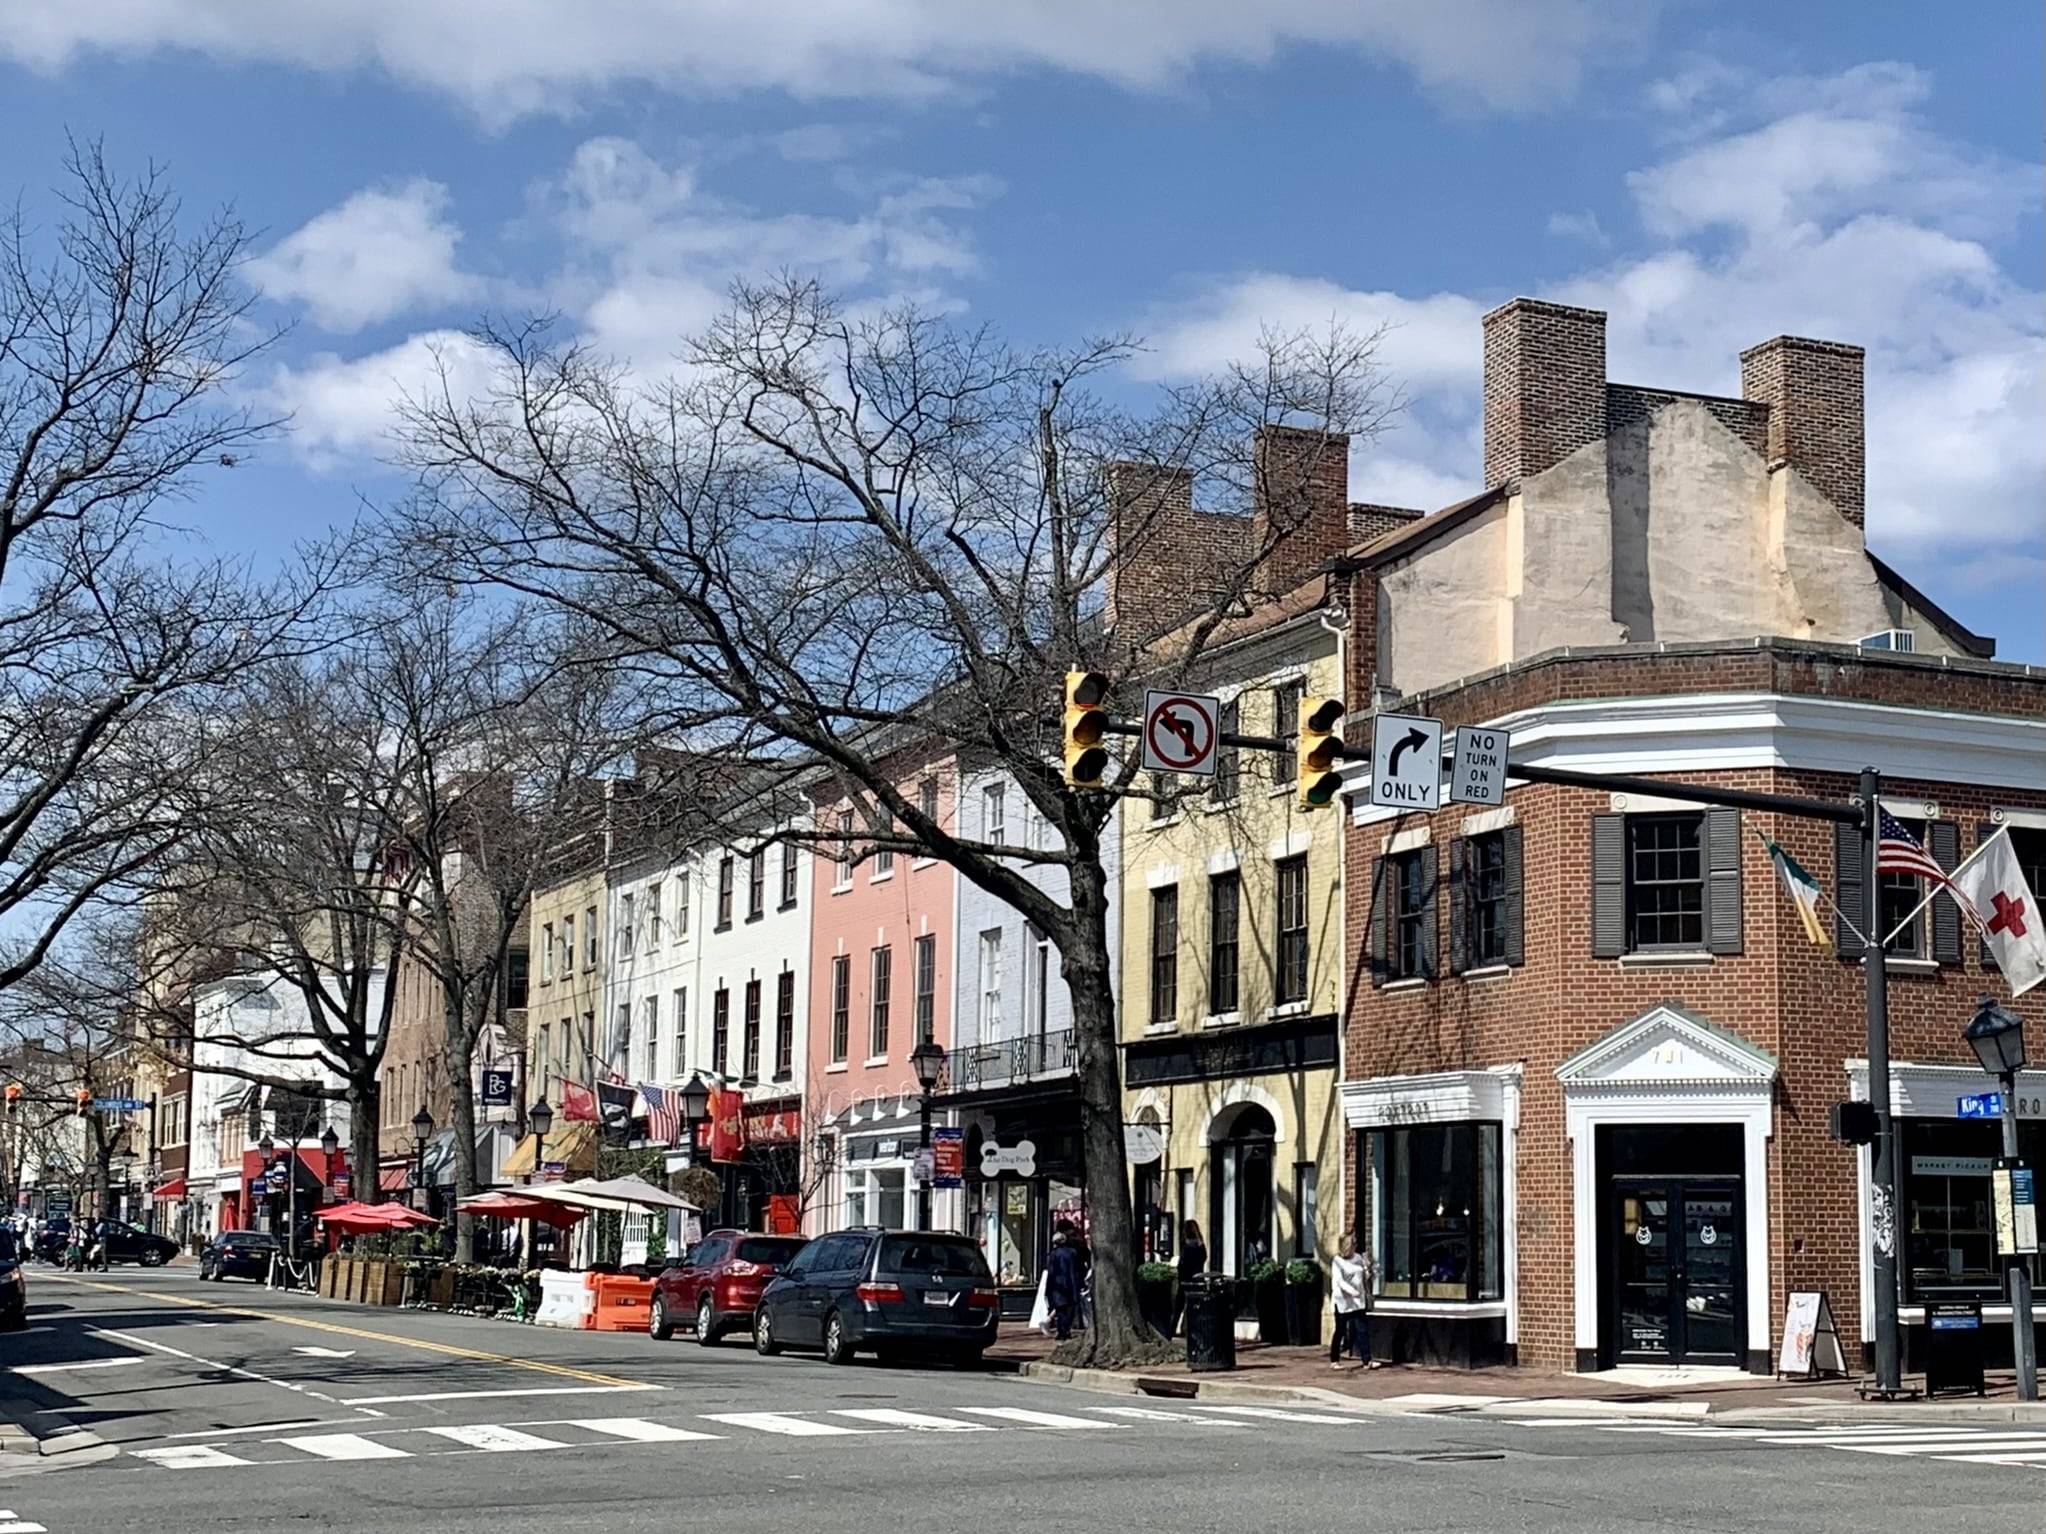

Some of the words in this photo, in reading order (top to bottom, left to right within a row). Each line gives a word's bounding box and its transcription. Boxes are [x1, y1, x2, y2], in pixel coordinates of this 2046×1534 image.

[1470, 734, 1494, 750] NO
[1466, 752, 1496, 767] TURN
[1470, 769, 1488, 782] ON
[1382, 782, 1430, 801] ONLY
[1465, 785, 1489, 798] RED
[1961, 1098, 1985, 1116] King
